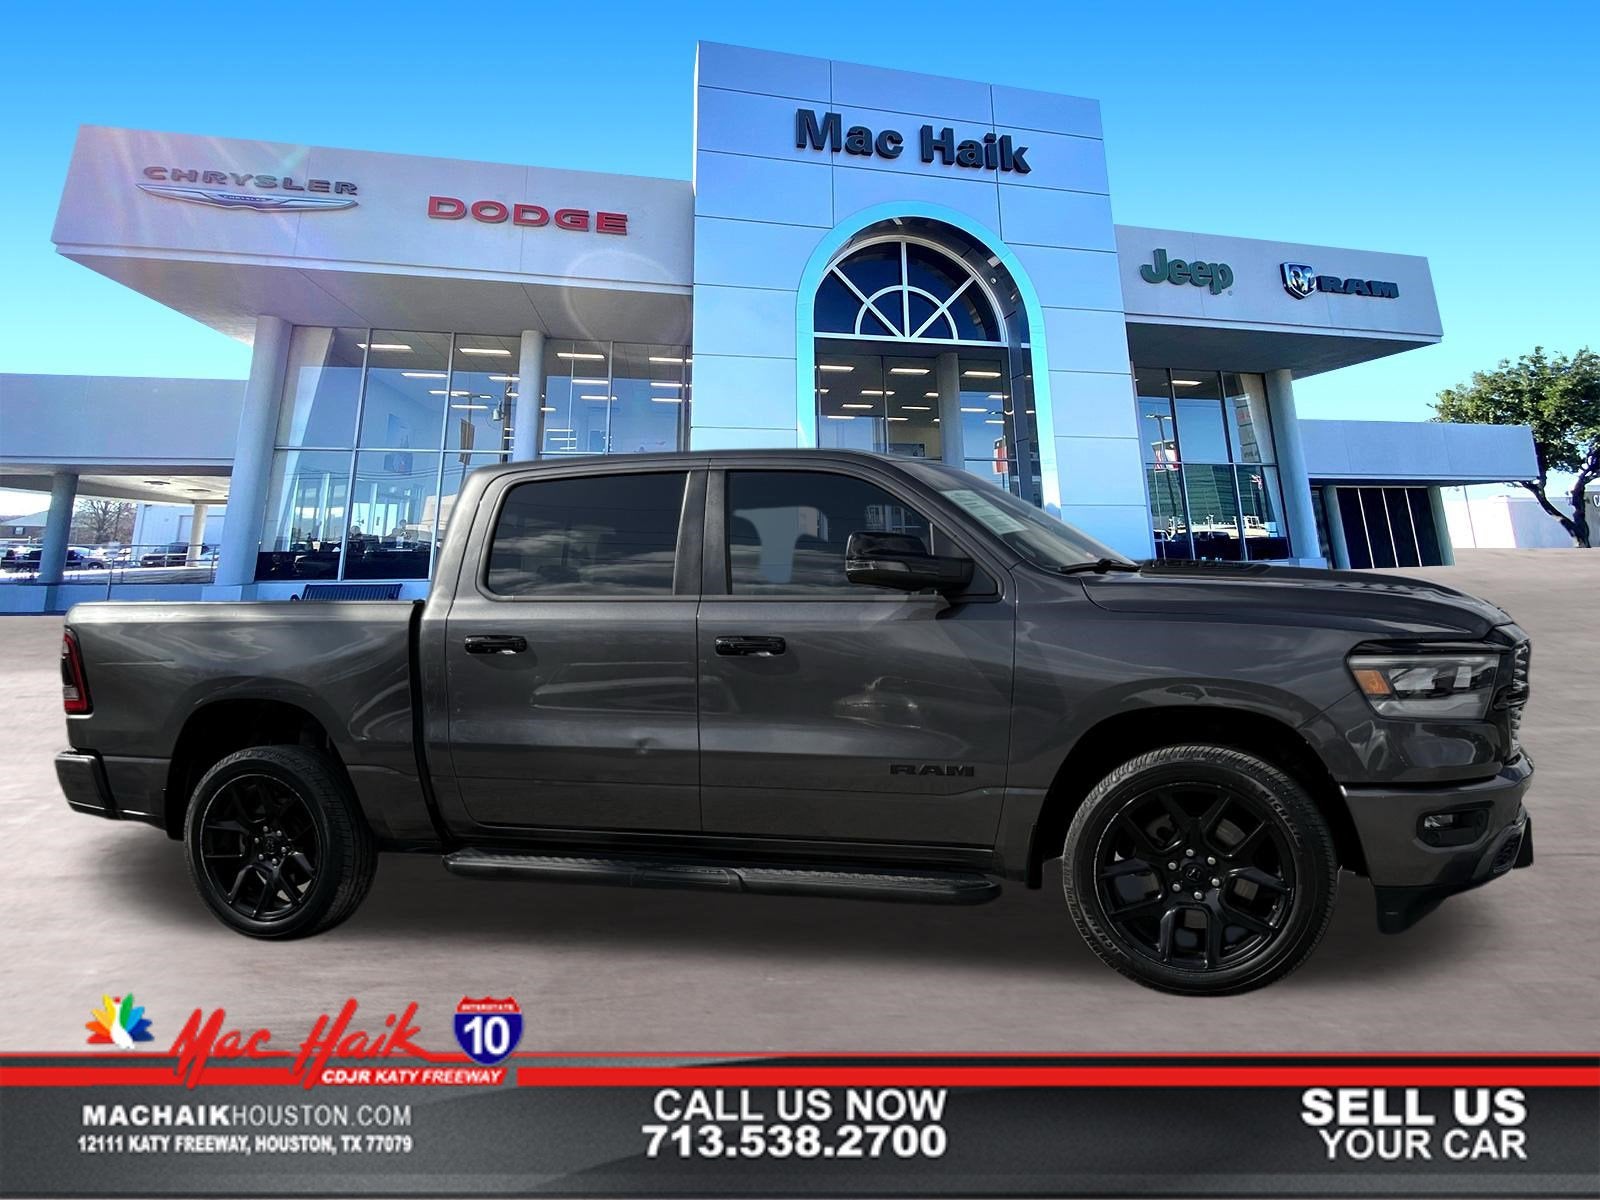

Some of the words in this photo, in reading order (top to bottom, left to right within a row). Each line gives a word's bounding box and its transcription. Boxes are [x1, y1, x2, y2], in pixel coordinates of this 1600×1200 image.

[795, 108, 905, 160] Mac
[919, 124, 1032, 174] Haik
[143, 166, 358, 196] CHRYSLER
[428, 195, 628, 236] DODGE
[1139, 248, 1234, 296] Jeep
[1316, 275, 1400, 299] RAM
[889, 763, 975, 777] RAM
